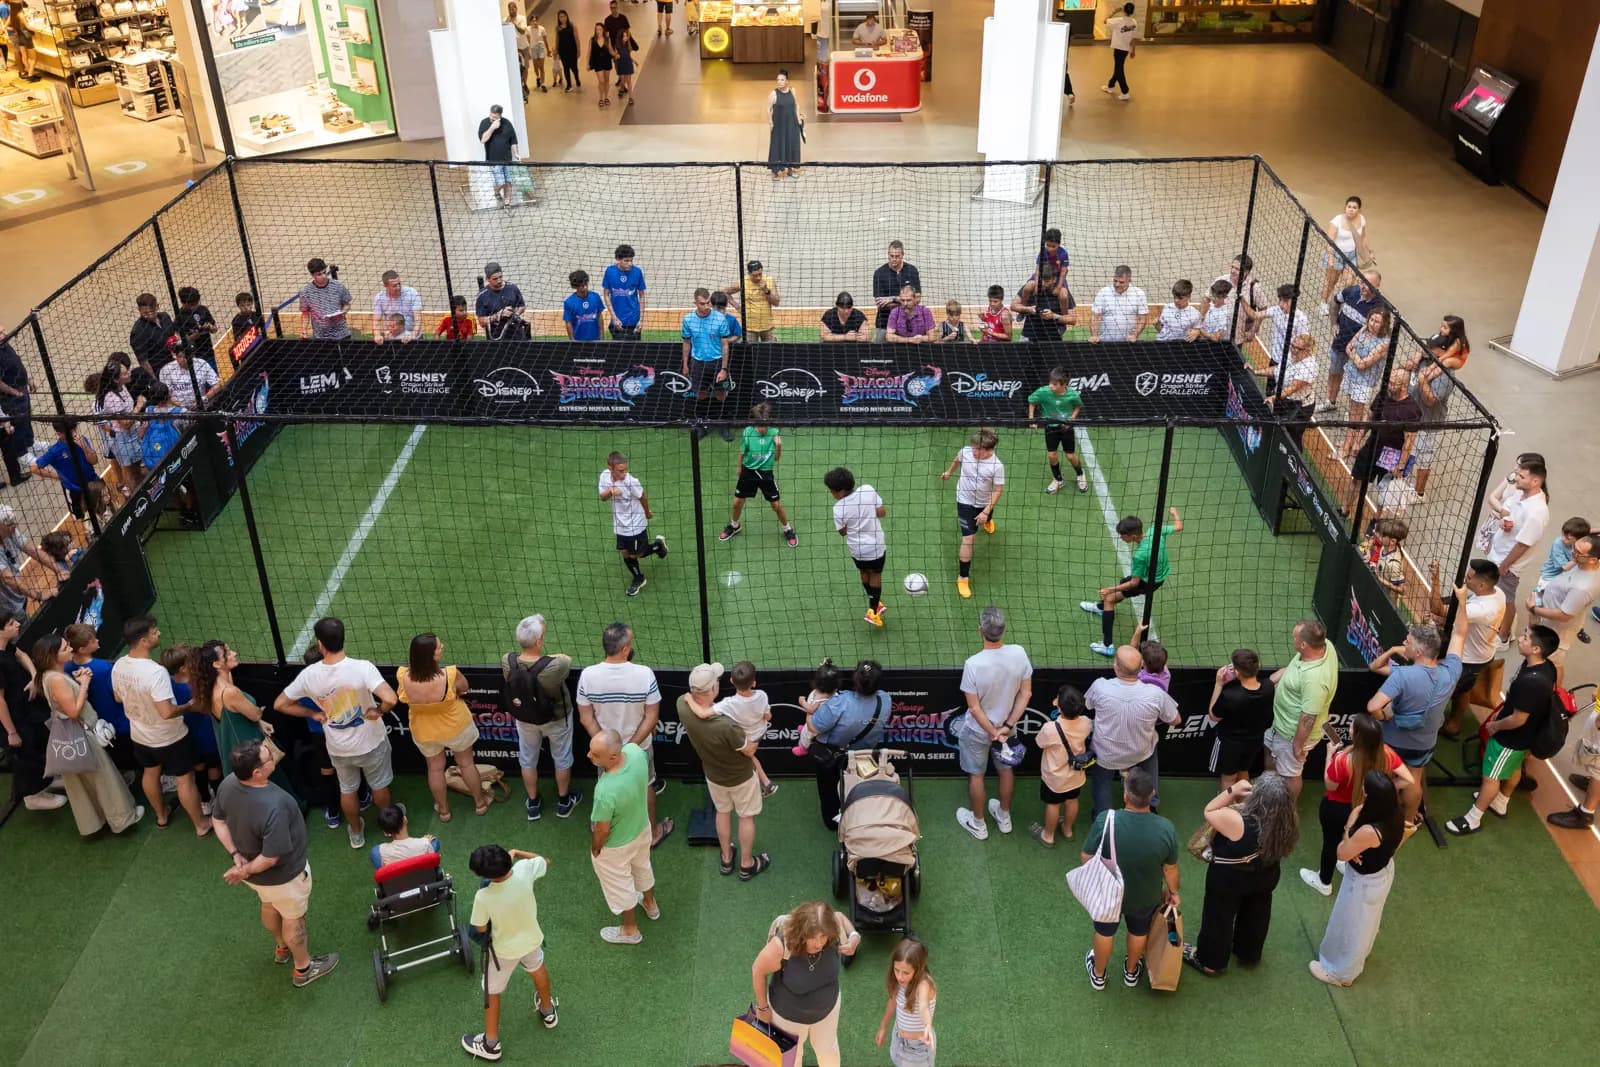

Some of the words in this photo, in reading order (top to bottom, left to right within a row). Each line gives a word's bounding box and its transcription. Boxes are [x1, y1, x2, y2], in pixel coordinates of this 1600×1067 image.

[841, 92, 889, 103] vodafone
[400, 372, 448, 382] DISNEY
[552, 371, 626, 388] DRAGON
[838, 371, 911, 389] DRAGON
[1069, 373, 1110, 391] EMA
[1161, 373, 1213, 383] DISNEY
[842, 388, 910, 404] STRIKER
[51, 741, 87, 760] YOU
[477, 750, 509, 758] NUEVA
[927, 752, 955, 760] SERIE
